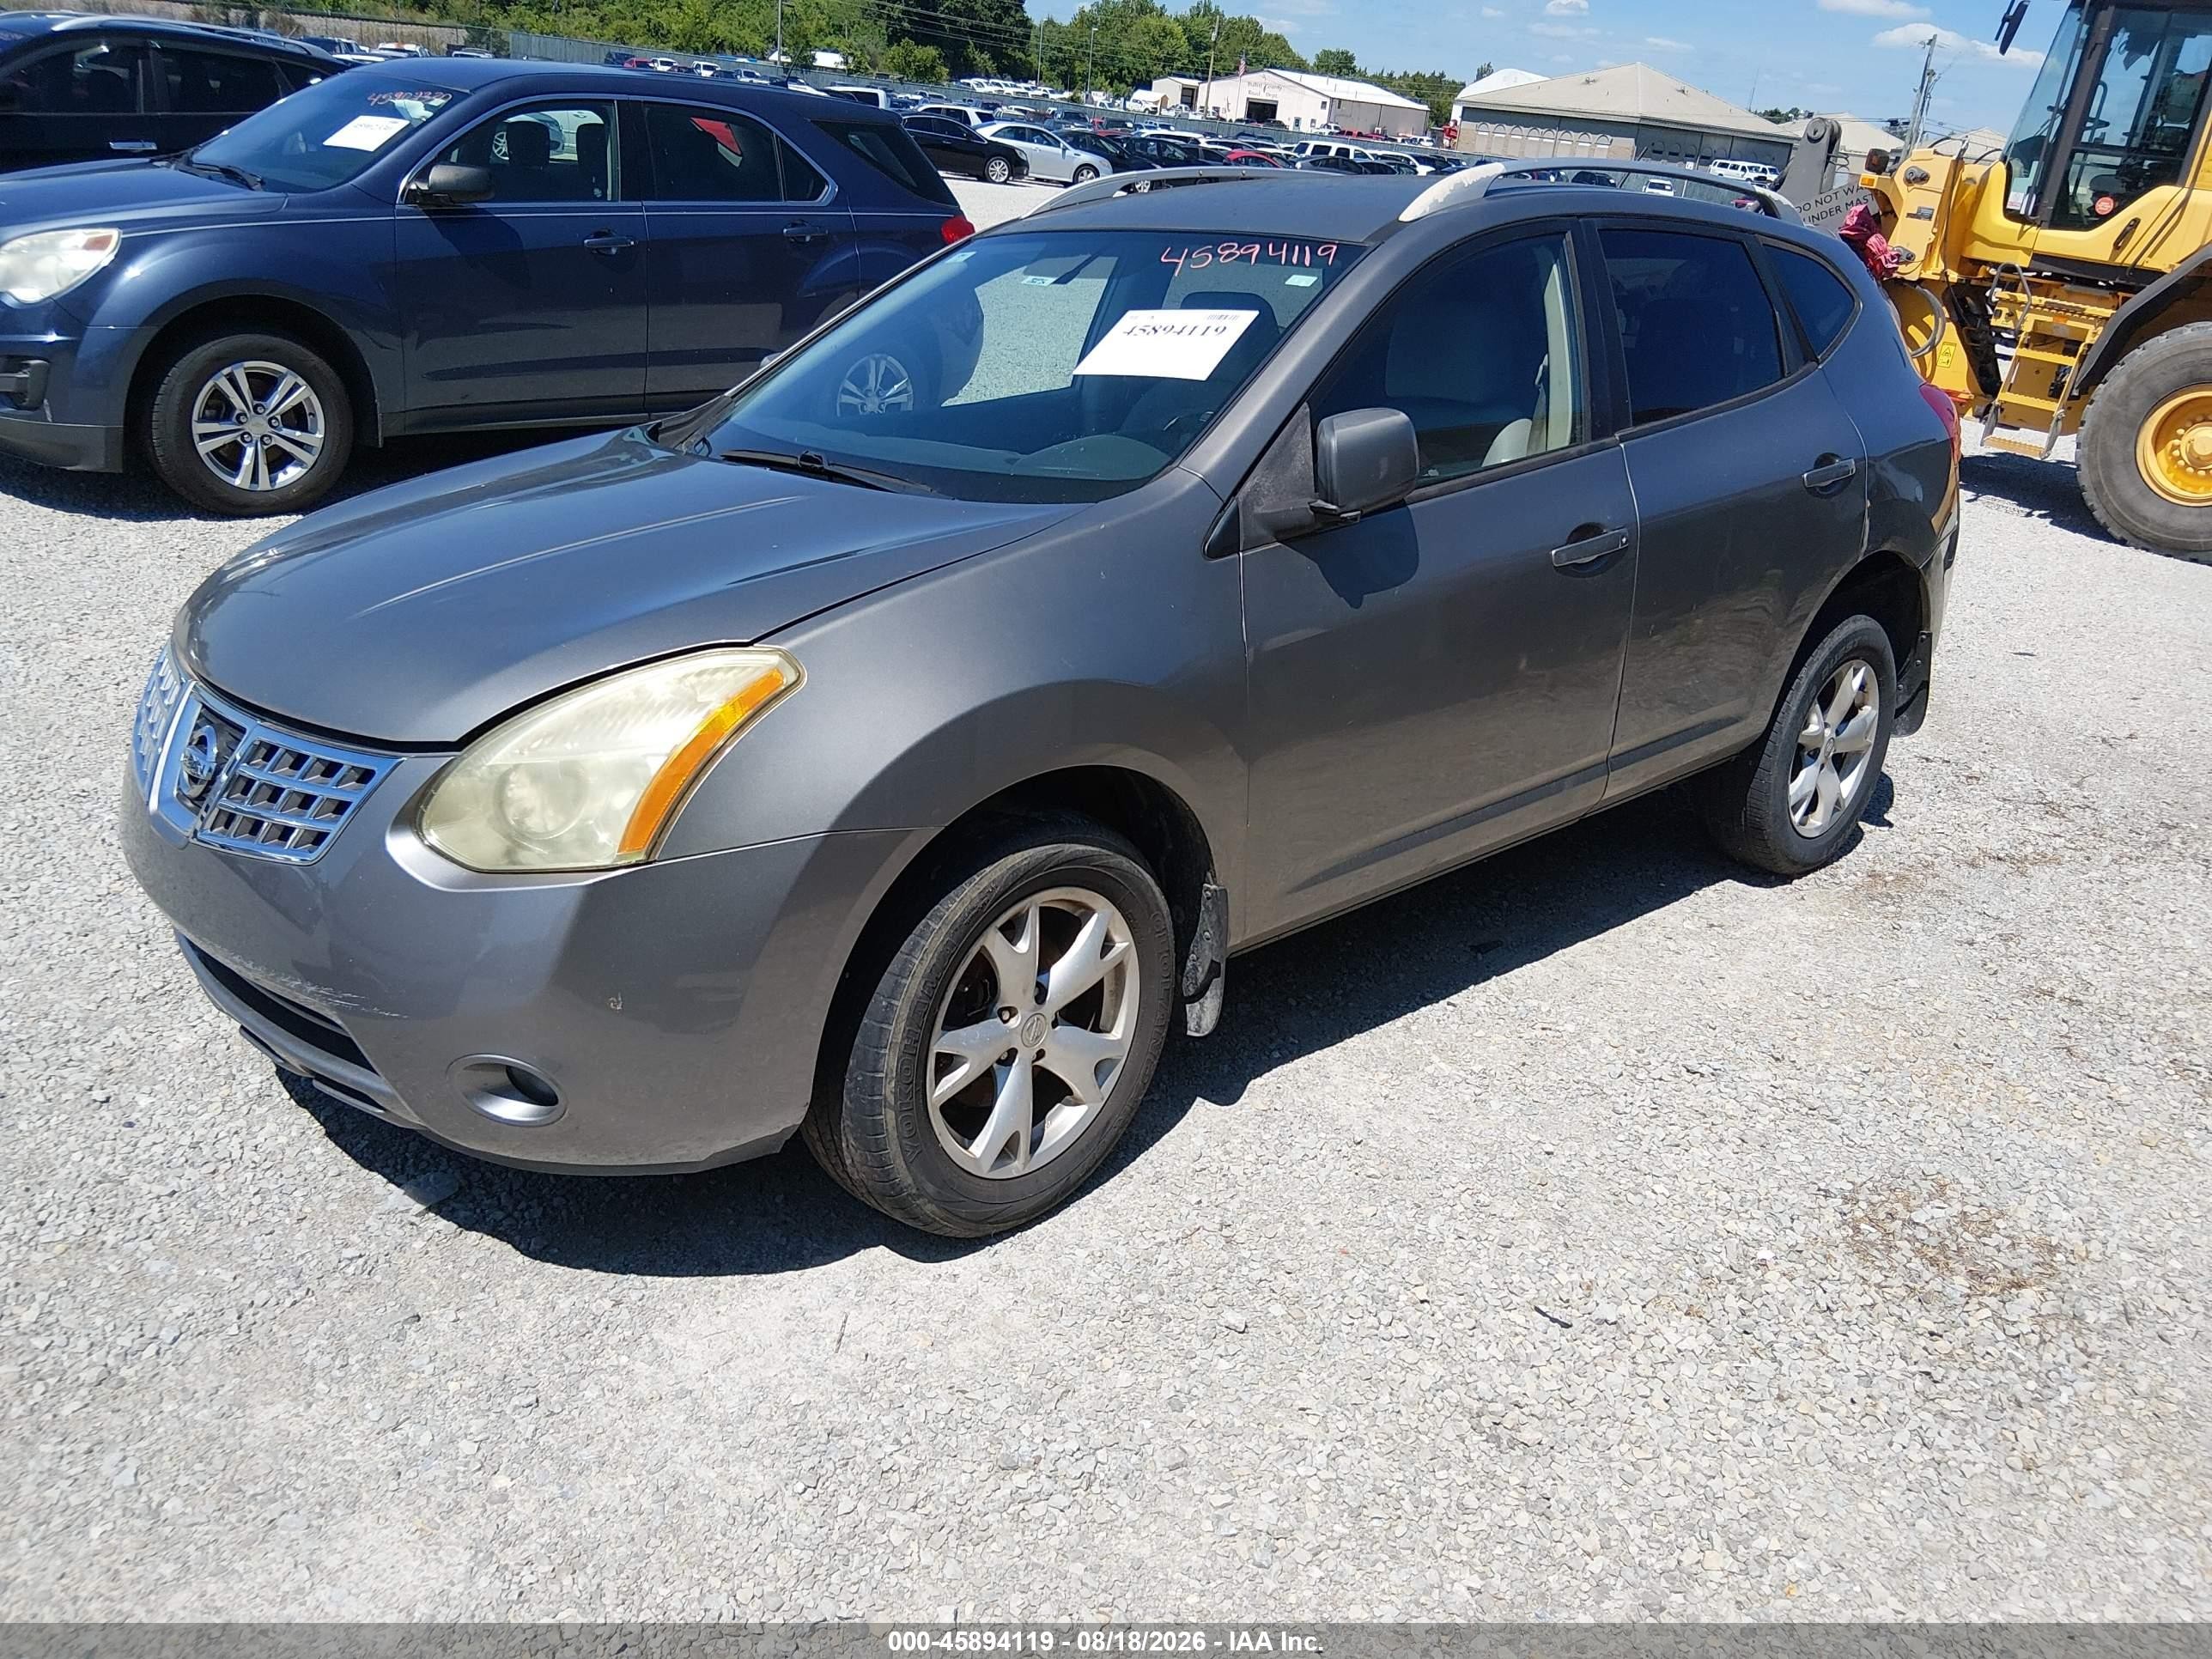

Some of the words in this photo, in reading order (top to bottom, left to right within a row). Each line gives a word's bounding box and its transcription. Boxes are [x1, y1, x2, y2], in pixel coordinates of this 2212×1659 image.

[1814, 191, 1840, 209] NOT
[1844, 193, 1875, 211] MAST
[1160, 240, 1340, 276] 45894119
[1122, 324, 1228, 337] 45894119
